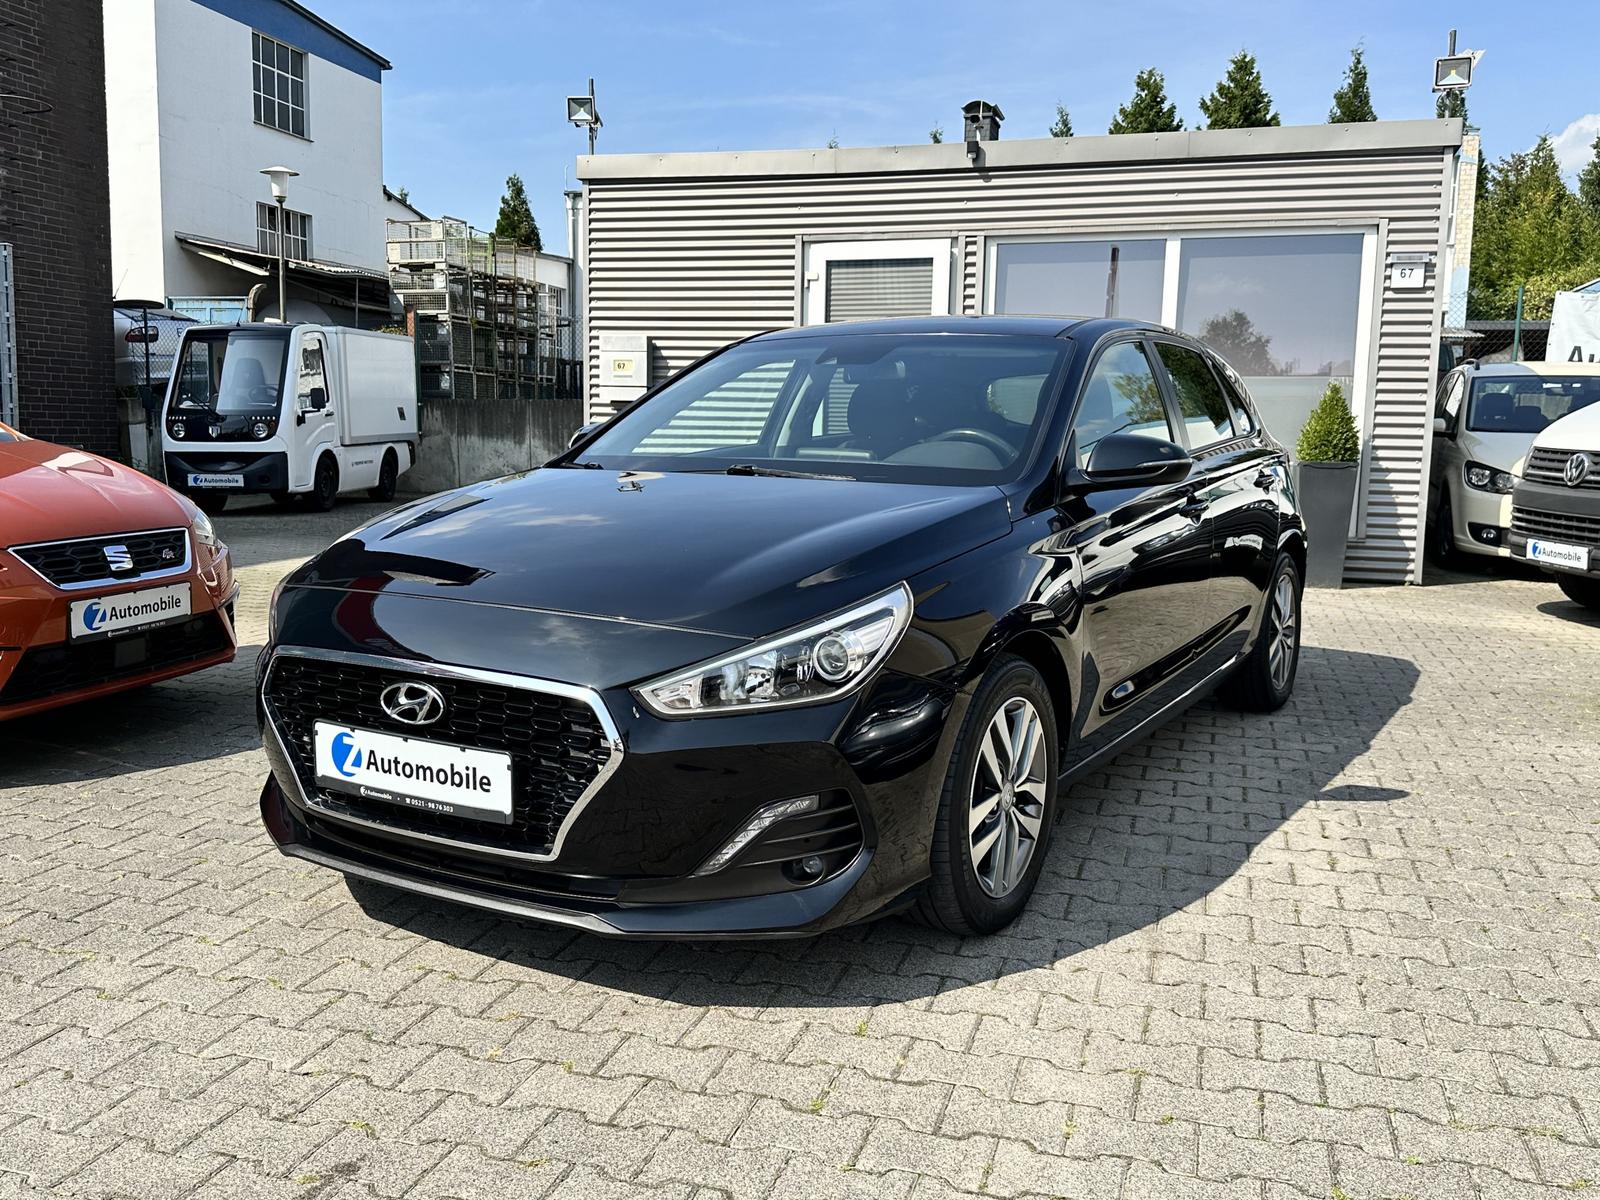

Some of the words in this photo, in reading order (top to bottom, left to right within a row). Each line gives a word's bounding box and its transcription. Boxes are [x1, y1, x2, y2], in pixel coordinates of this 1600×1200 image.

[1400, 268, 1414, 278] 67
[1542, 547, 1582, 562] Automobile
[109, 594, 181, 621] Automobile
[366, 749, 492, 793] Automobile
[368, 790, 392, 800] Automobile
